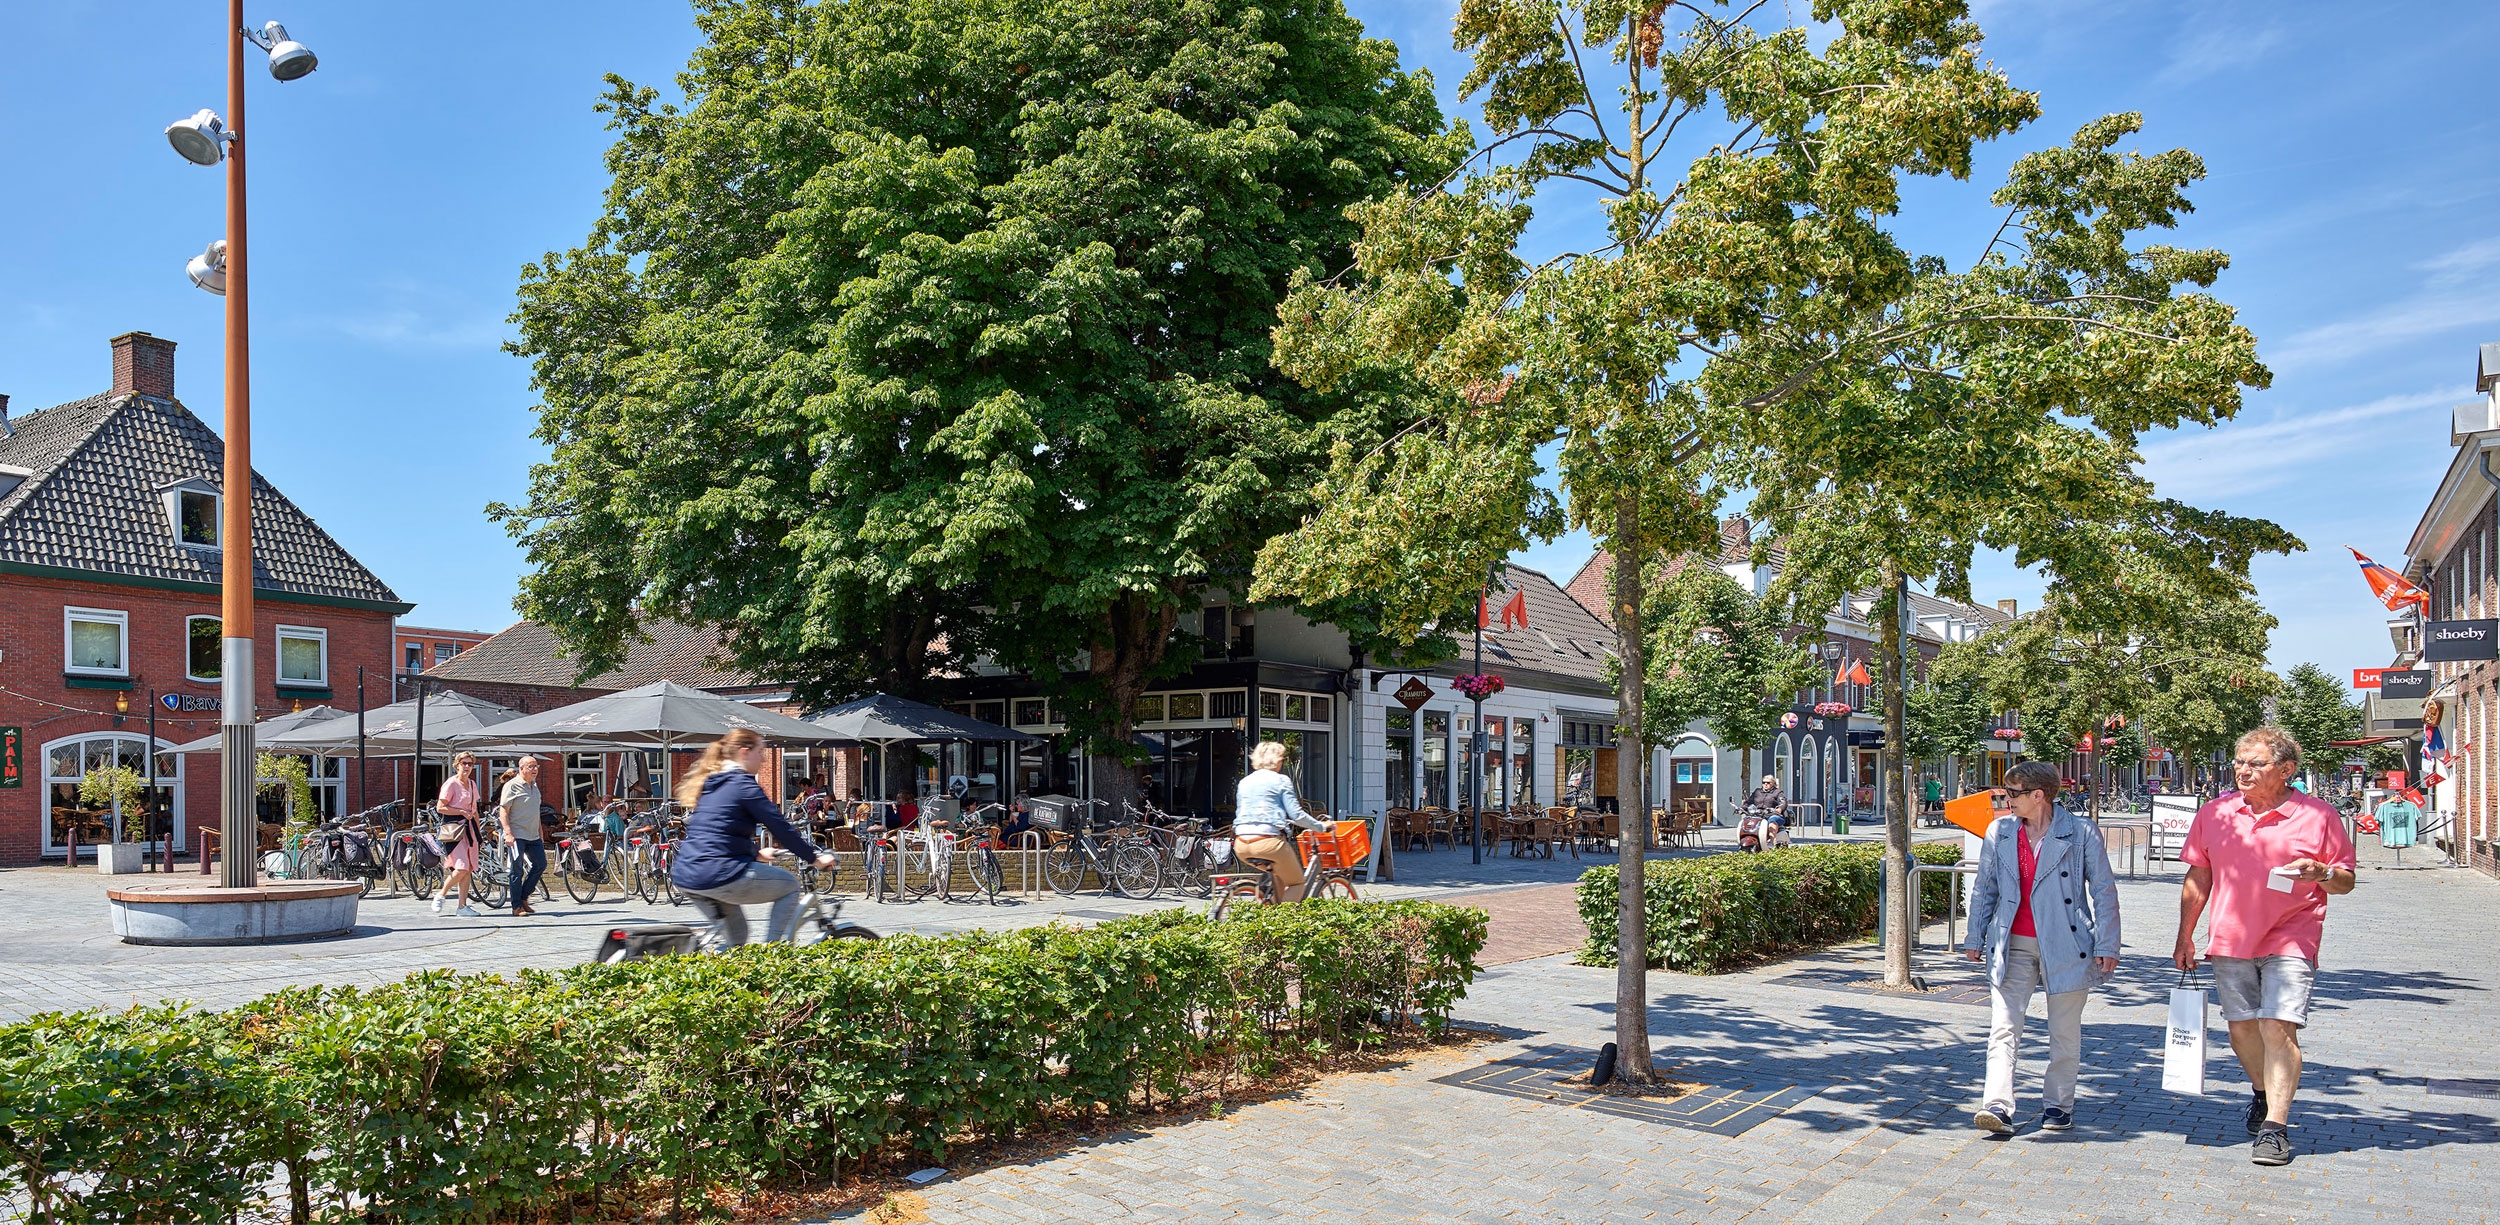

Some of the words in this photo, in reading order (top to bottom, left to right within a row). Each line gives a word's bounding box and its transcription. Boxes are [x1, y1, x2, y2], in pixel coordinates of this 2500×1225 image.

[2436, 627, 2487, 641] shoeby
[2388, 675, 2424, 685] shoeby
[4, 736, 18, 777] PALM
[2163, 818, 2190, 829] 50%
[2171, 1039, 2192, 1048] Family
